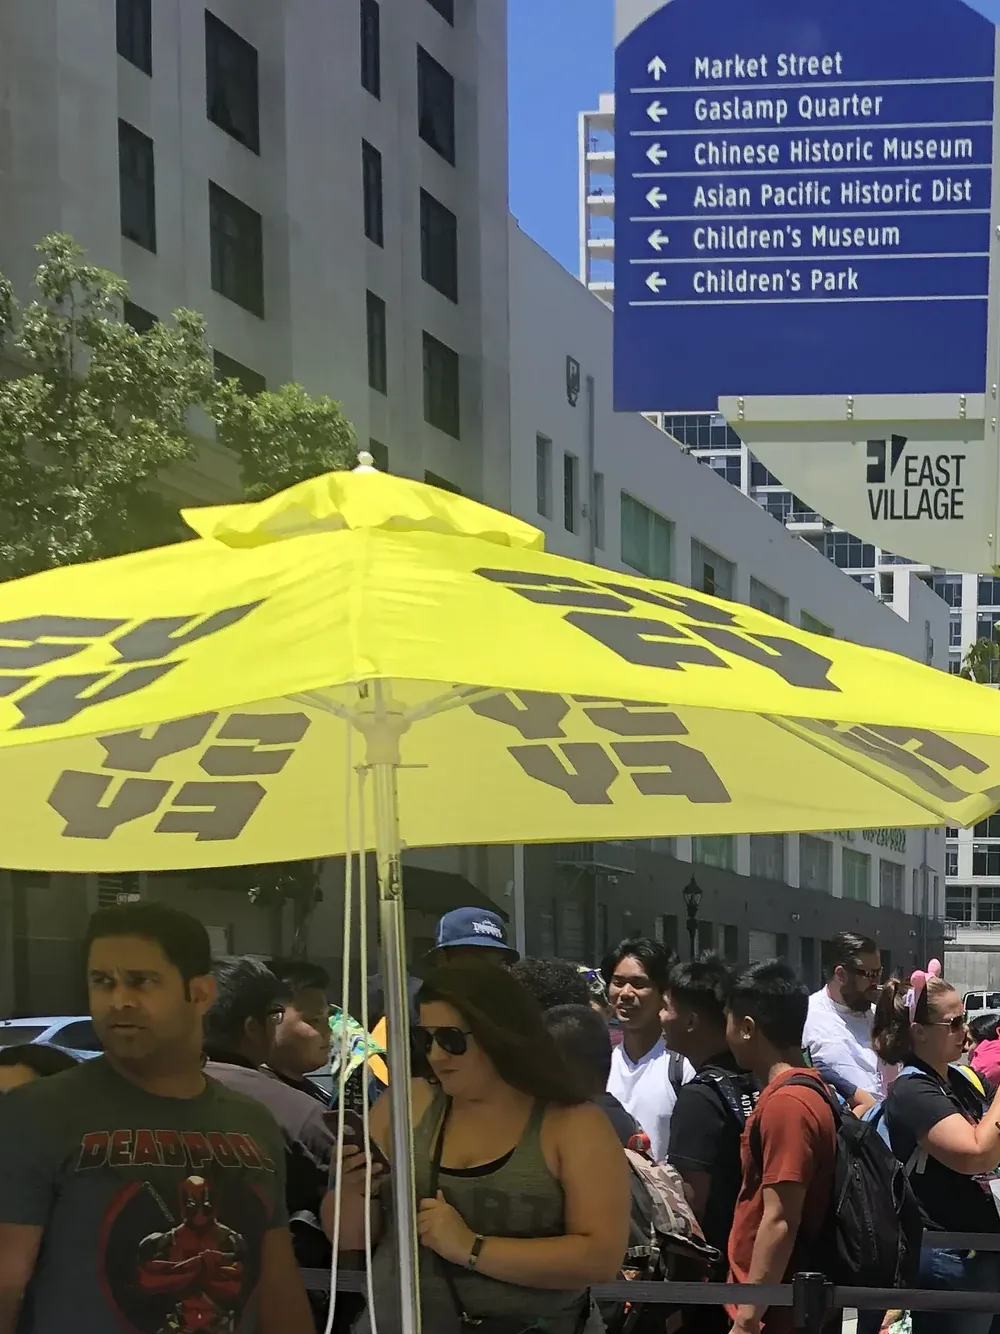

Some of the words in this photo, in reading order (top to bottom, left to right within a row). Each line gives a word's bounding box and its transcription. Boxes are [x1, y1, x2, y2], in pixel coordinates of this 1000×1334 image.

[694, 54, 768, 79] Market
[778, 51, 843, 77] Street
[694, 97, 788, 124] Gaslamp
[798, 94, 883, 120] Quarter
[694, 141, 779, 166] Chinese
[790, 138, 873, 163] Historic
[884, 136, 973, 160] Museum
[694, 185, 750, 208] Asian
[761, 181, 831, 207] Pacific
[841, 179, 922, 204] Historic
[932, 178, 972, 202] Dist
[694, 225, 801, 250] Children's
[812, 223, 900, 247] Museum
[693, 269, 801, 293] Children's
[811, 267, 859, 291] Park
[904, 454, 966, 487] EAST
[868, 488, 964, 520] VILLAGE
